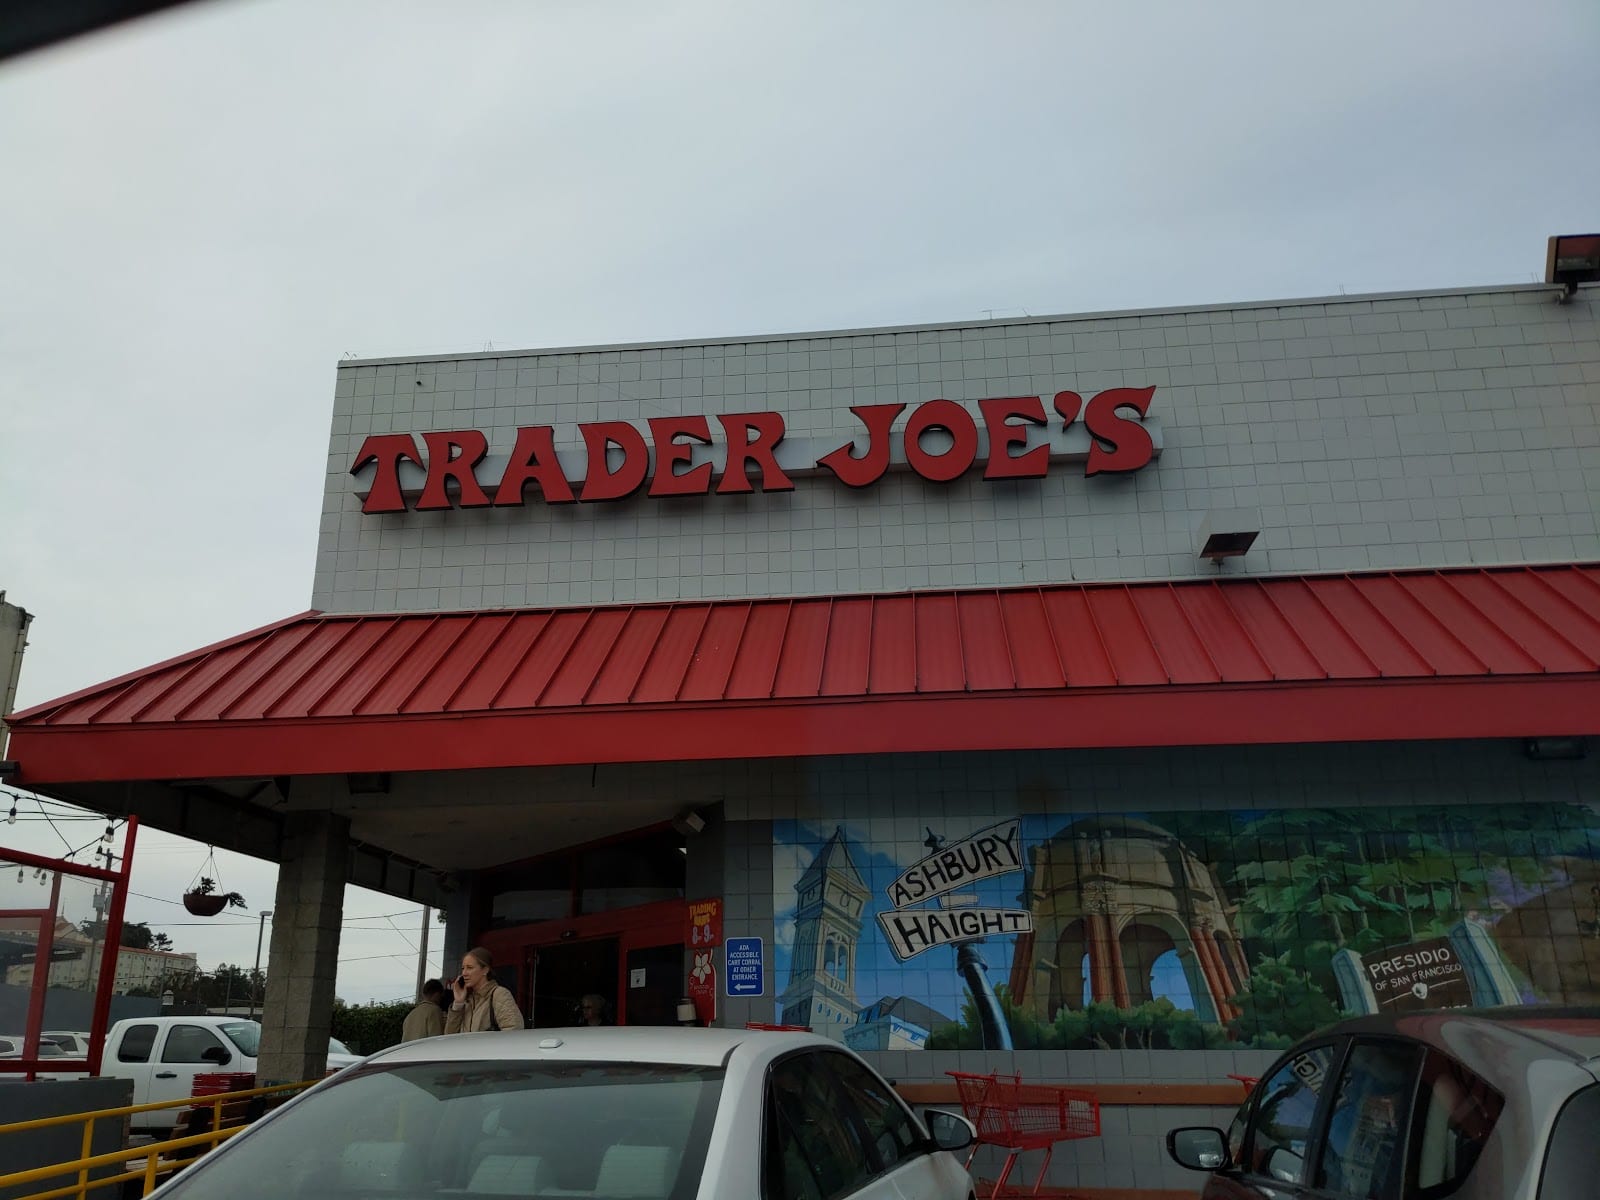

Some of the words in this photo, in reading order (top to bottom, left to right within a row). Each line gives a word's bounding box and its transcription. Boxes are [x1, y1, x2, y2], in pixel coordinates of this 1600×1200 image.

[350, 412, 794, 515] TRADER
[816, 385, 1156, 488] JOE'S
[893, 827, 1019, 906] ASHBURY
[893, 912, 1025, 953] HAIGHT
[730, 951, 760, 959] ACCESSIBLE
[1368, 947, 1450, 979] PRESIDIO
[731, 973, 759, 981] ENTRANCE
[1375, 980, 1388, 991] OF
[1390, 975, 1411, 989] SAN
[1411, 963, 1462, 981] FRANCISCO
